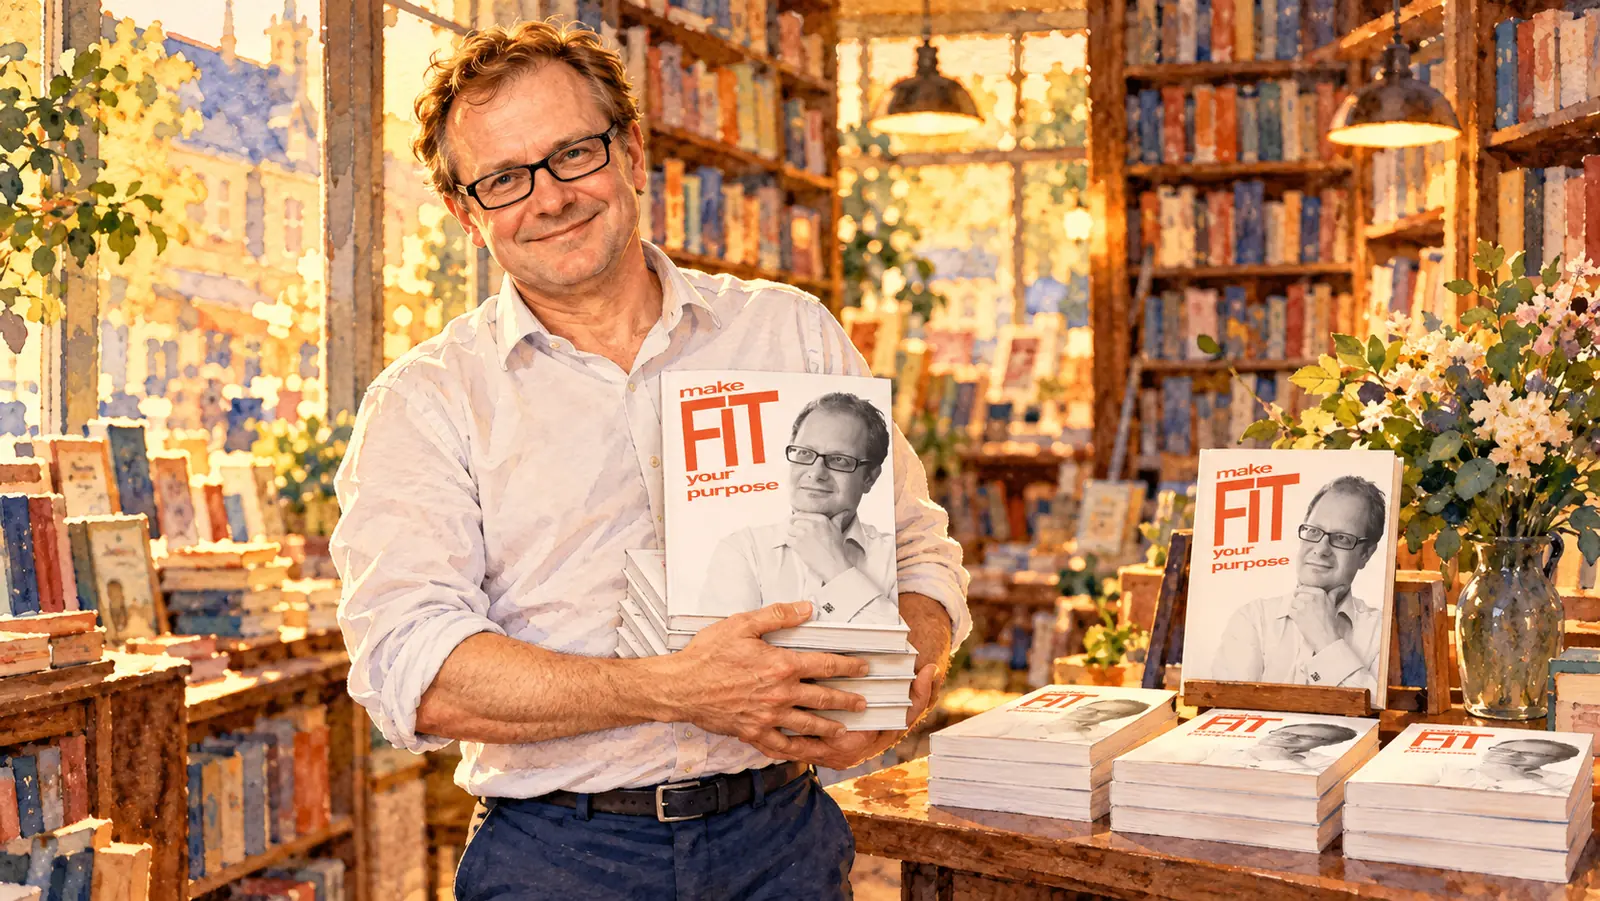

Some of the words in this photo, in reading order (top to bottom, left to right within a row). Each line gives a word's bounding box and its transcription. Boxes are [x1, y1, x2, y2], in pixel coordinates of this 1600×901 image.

[680, 380, 744, 398] make
[686, 469, 735, 487] your
[1216, 463, 1273, 479] make
[687, 481, 779, 501] purpose
[1212, 546, 1255, 560] your
[1211, 556, 1289, 574] purpose
